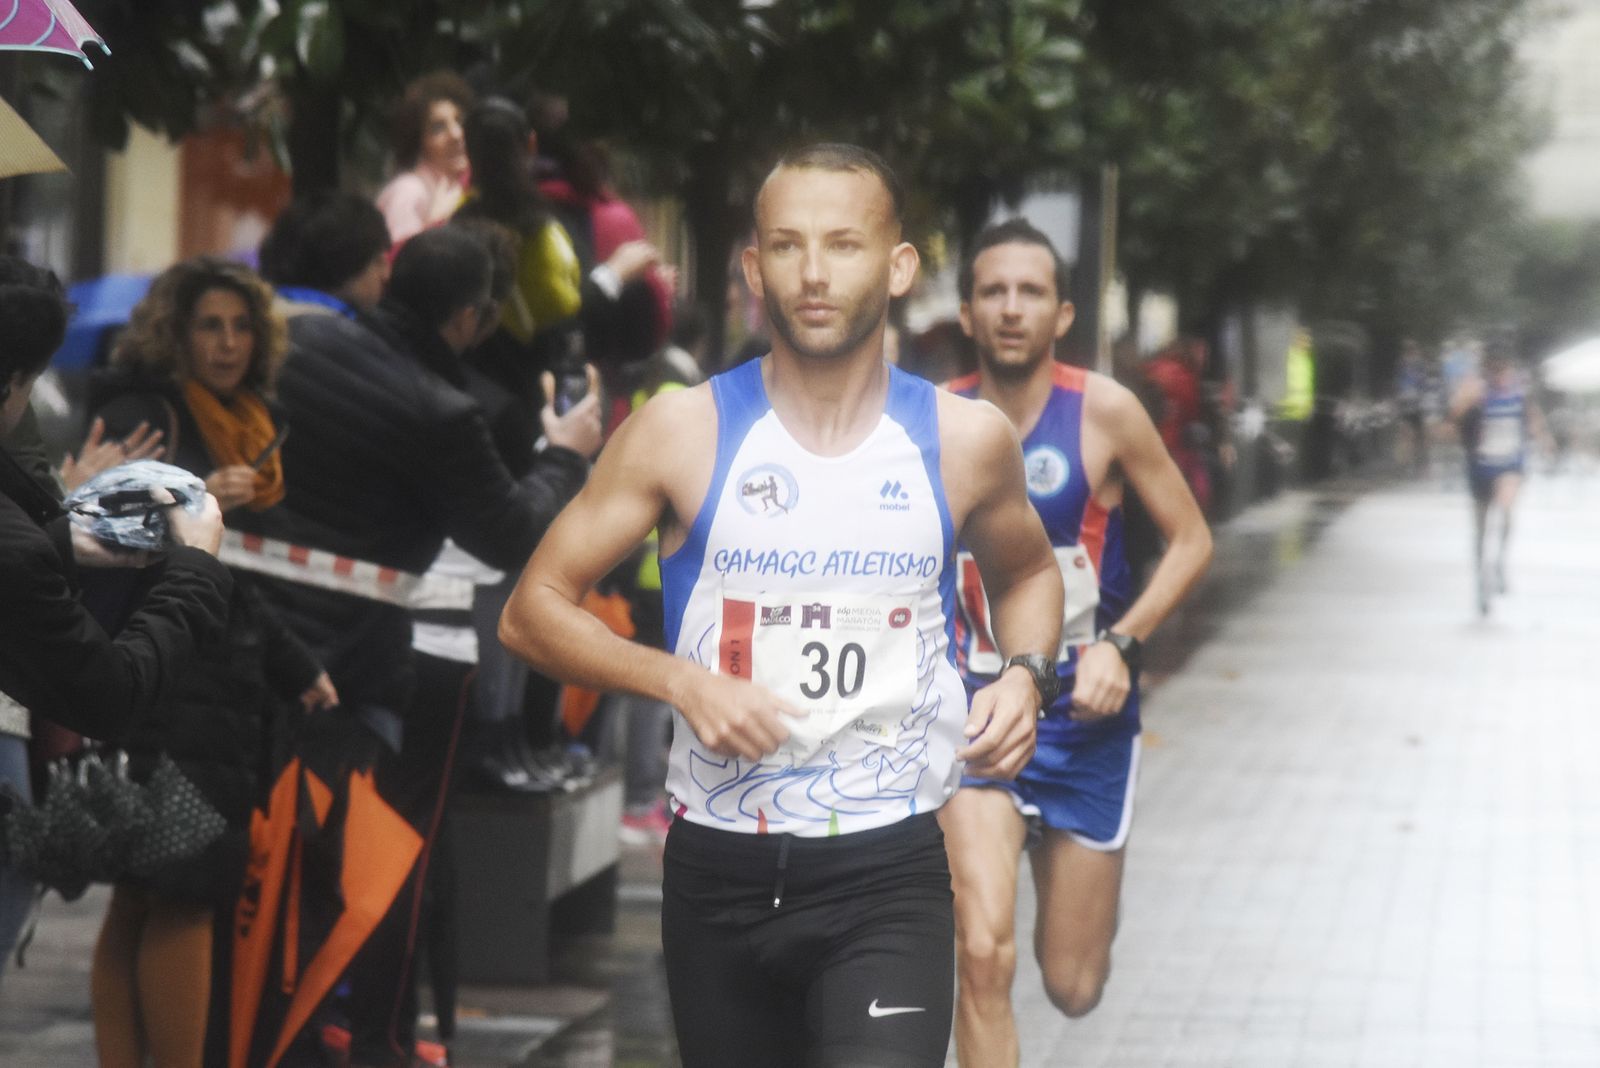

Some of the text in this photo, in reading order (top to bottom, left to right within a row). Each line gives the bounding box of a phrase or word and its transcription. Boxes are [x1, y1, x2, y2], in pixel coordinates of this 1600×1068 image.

[879, 503, 911, 512] mobel
[821, 550, 938, 578] ATLETISMO
[851, 607, 882, 617] MEDIA
[799, 641, 867, 700] 30
